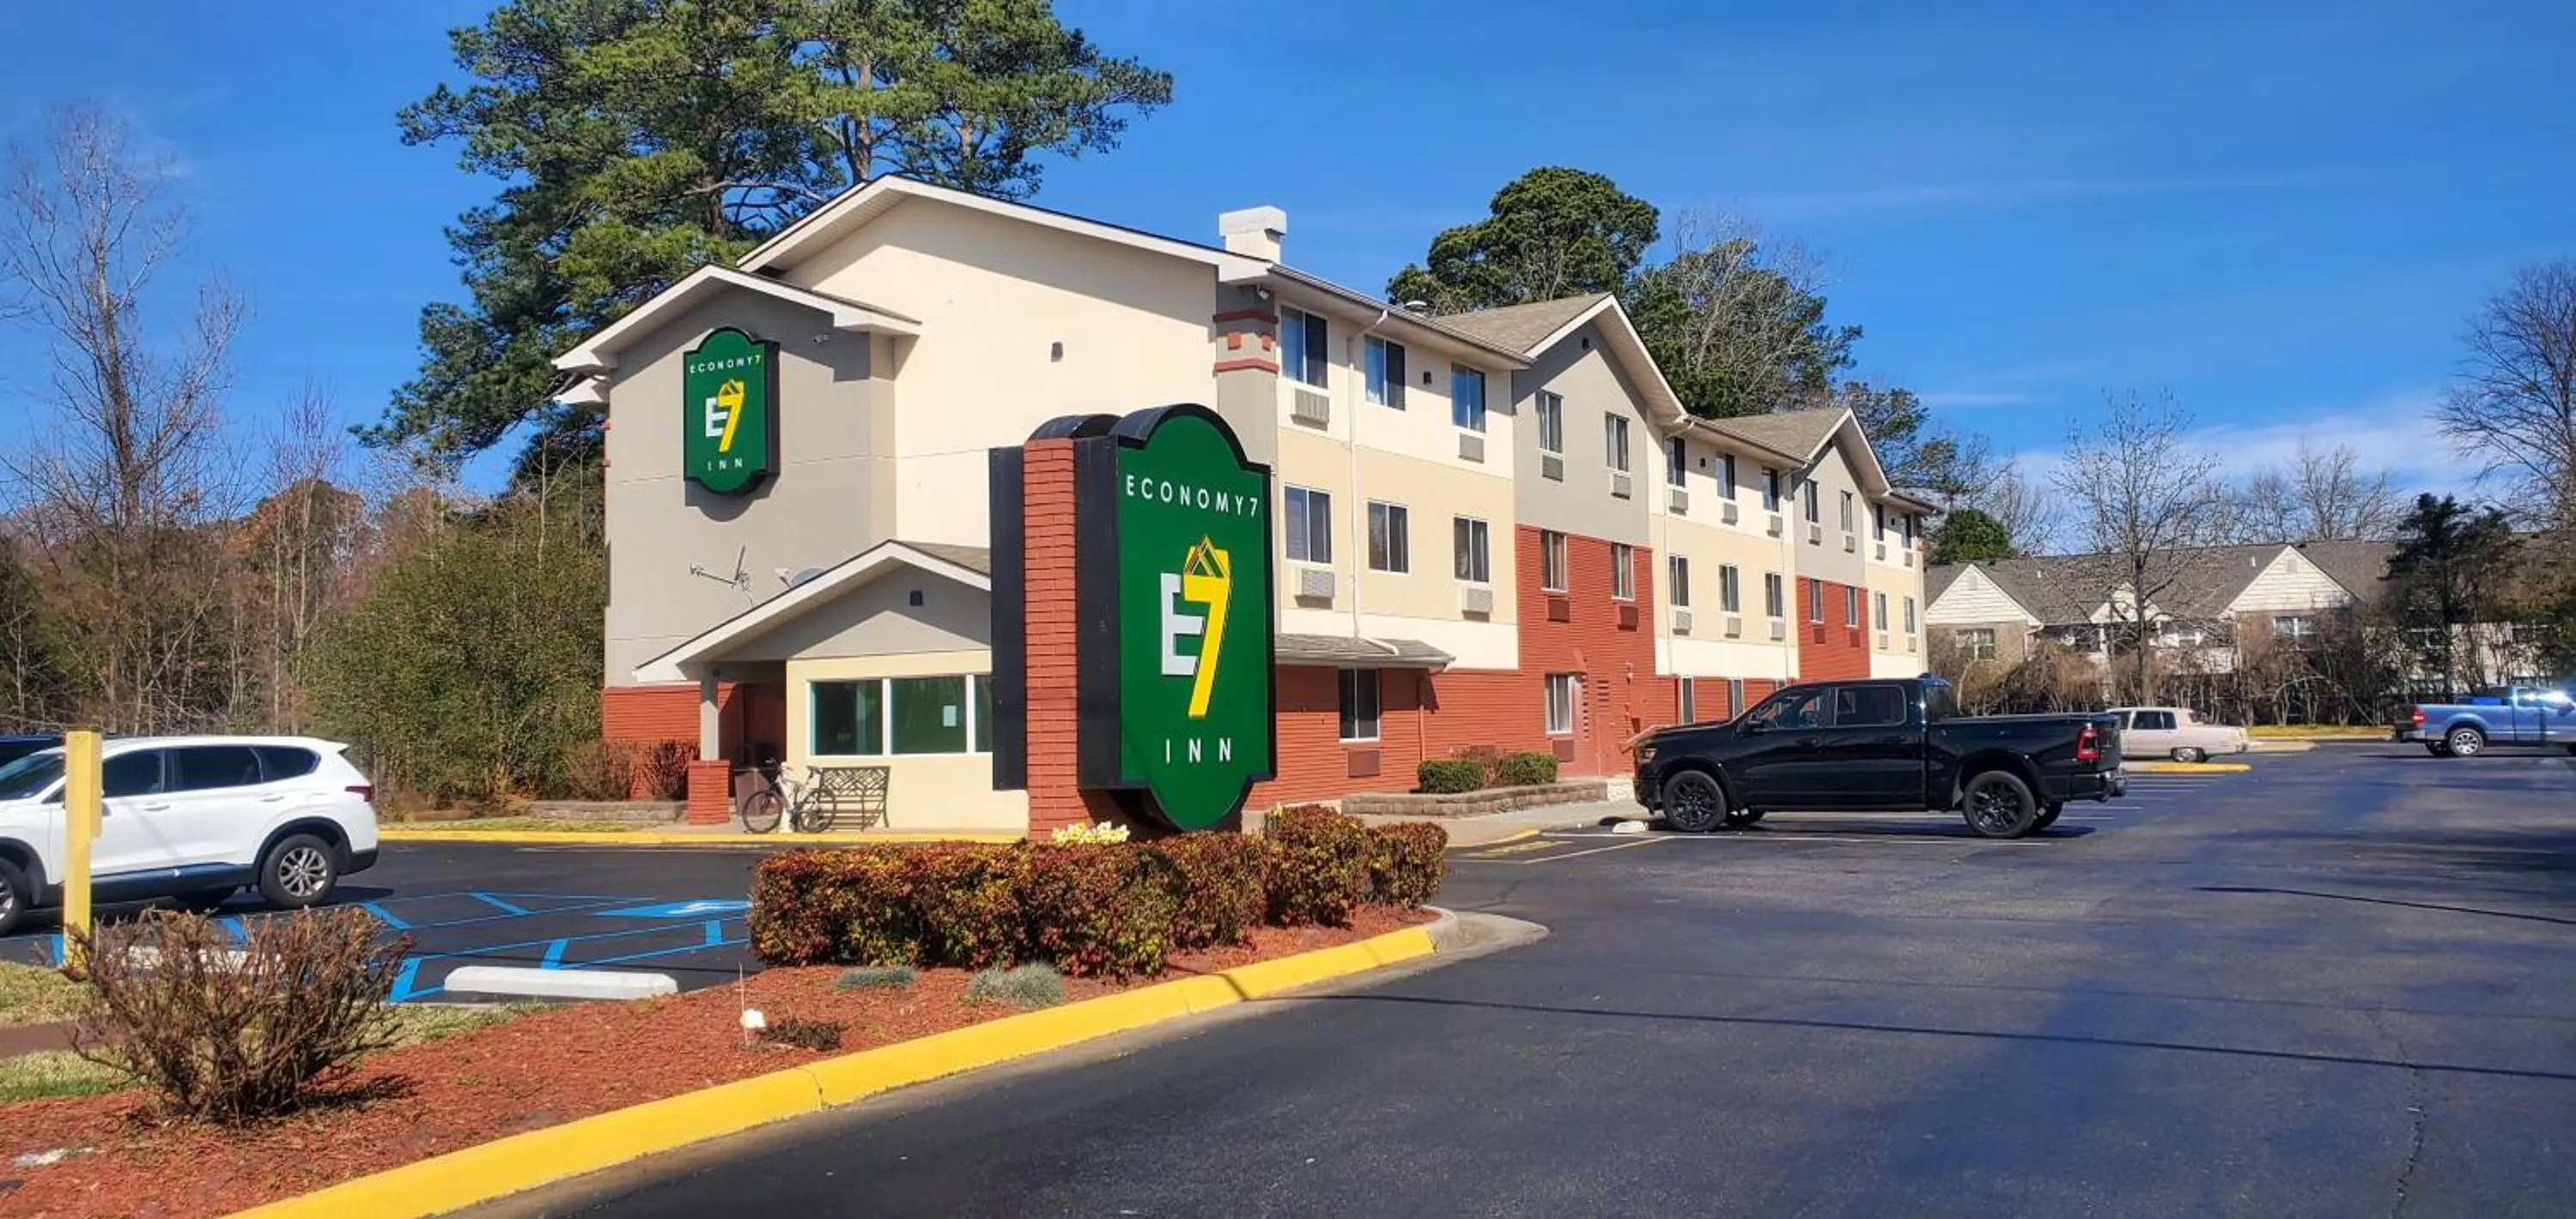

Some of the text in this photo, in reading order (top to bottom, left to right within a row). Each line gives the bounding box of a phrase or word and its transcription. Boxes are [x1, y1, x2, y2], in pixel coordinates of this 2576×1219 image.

[690, 355, 762, 373] ECONOMY7
[705, 379, 744, 453] E7
[708, 458, 743, 471] INN
[1127, 475, 1258, 517] ECONOMY7
[1160, 535, 1231, 718] E7
[1165, 738, 1231, 763] INN
